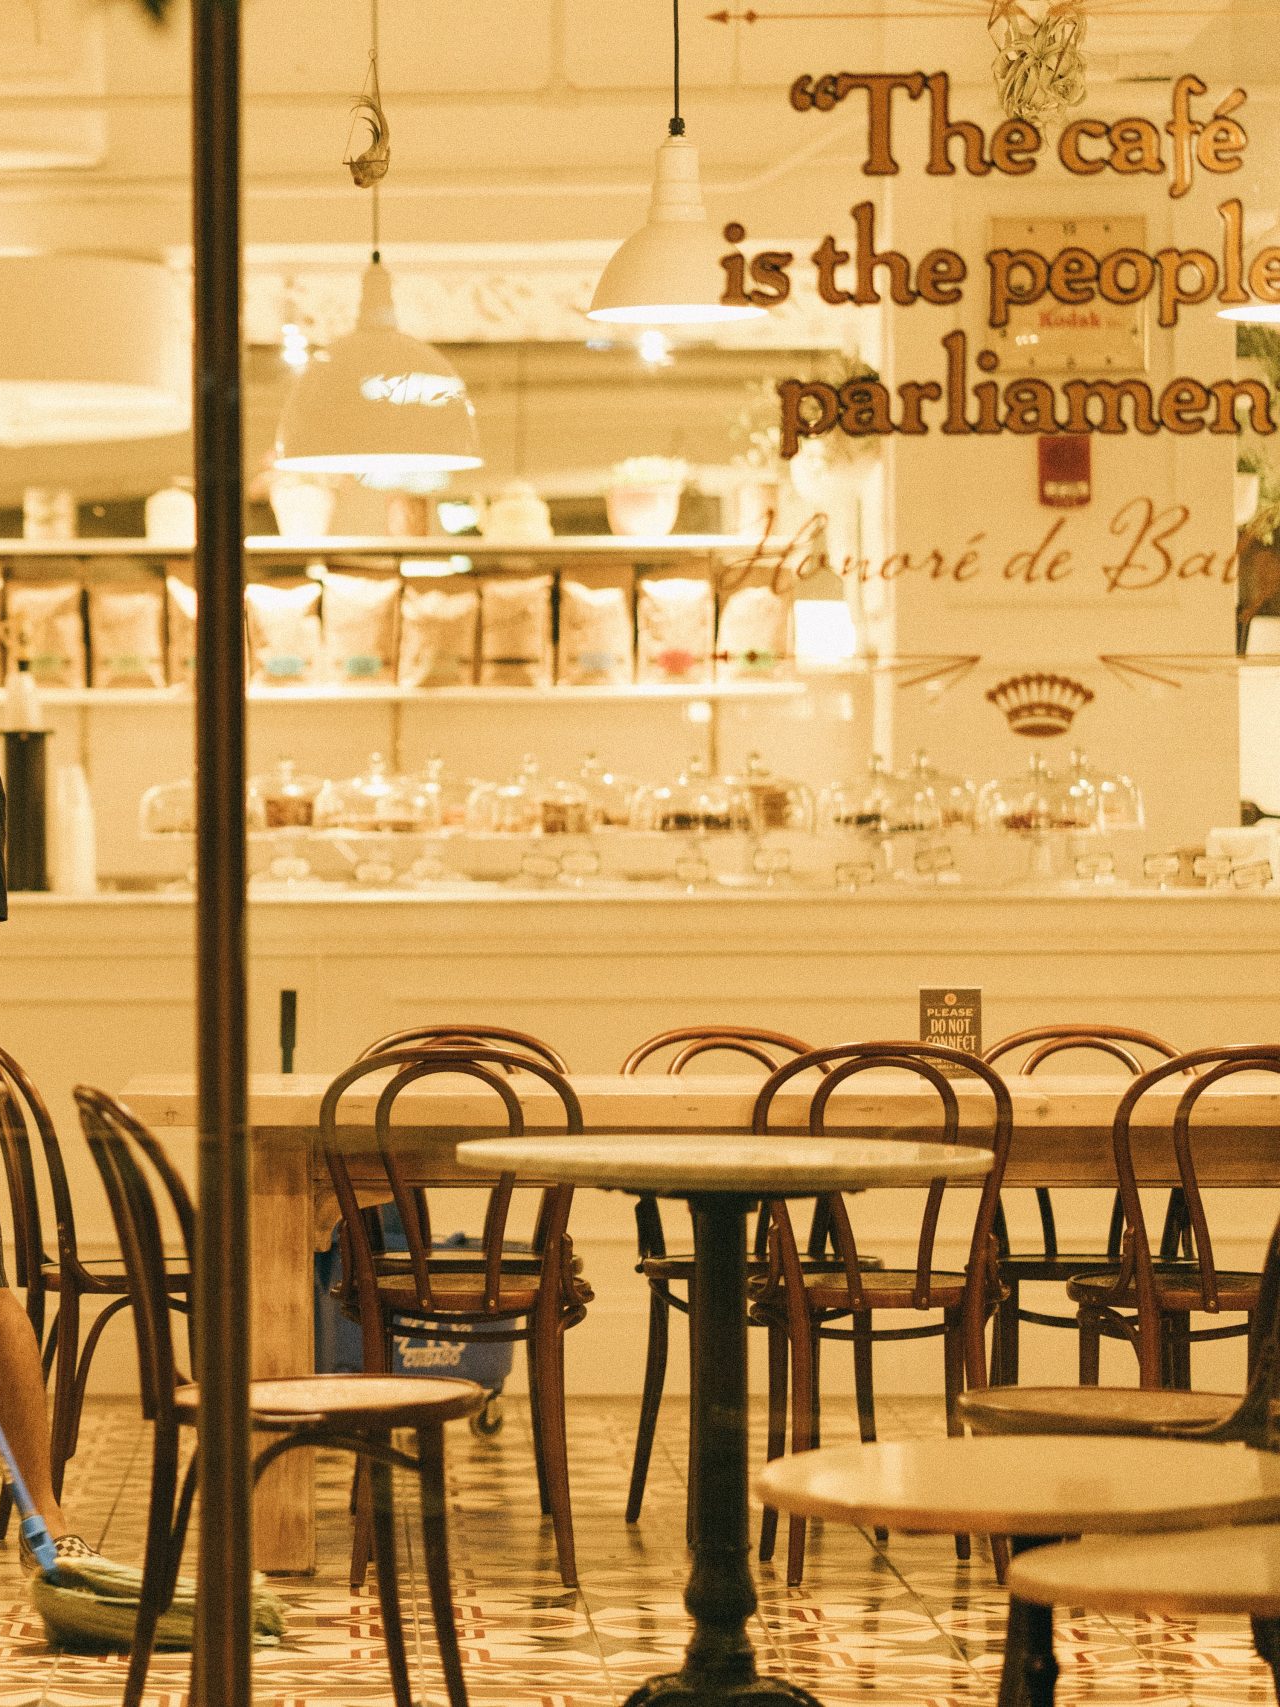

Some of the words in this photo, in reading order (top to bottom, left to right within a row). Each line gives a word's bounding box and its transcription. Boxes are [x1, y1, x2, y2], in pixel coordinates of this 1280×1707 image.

[1059, 73, 1248, 200] café
[719, 221, 793, 307] is
[811, 200, 968, 306] the
[984, 198, 1280, 329] people
[775, 328, 1280, 460] parliamen
[717, 507, 987, 596] Honoré
[1003, 516, 1072, 584] de
[927, 1008, 974, 1017] PLEASE
[930, 1019, 946, 1034] DO
[948, 1018, 971, 1034] NOT
